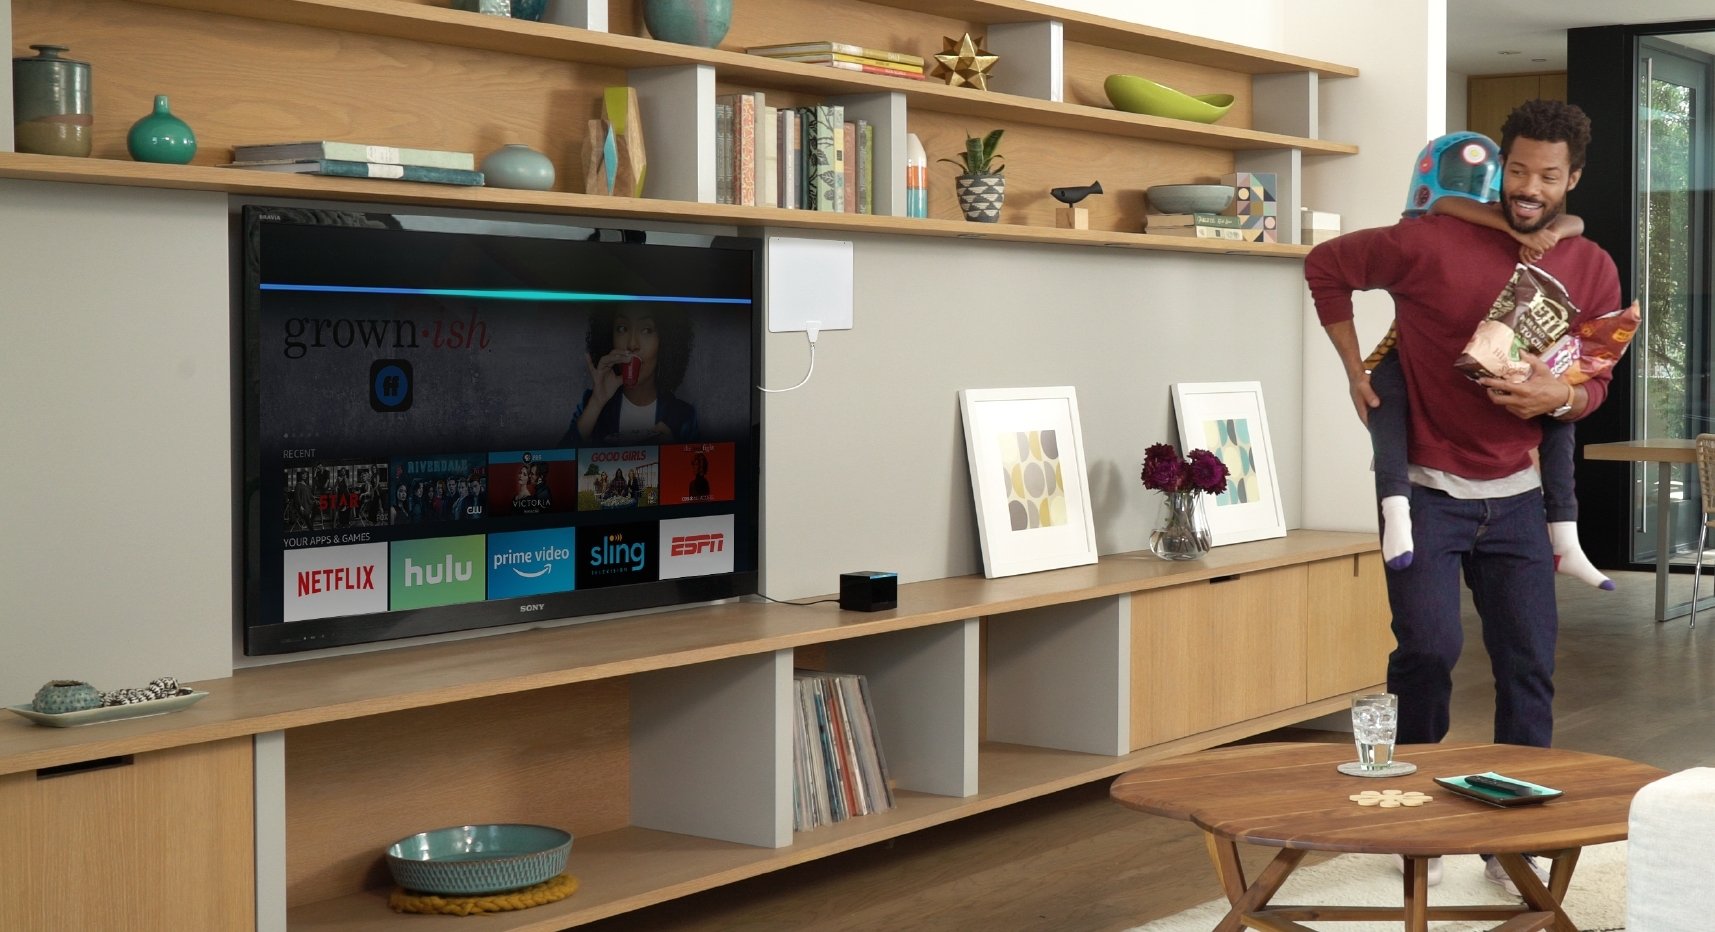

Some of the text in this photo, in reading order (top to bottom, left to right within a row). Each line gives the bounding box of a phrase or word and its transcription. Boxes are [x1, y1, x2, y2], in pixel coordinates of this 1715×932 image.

[283, 449, 316, 459] RECENT
[591, 451, 647, 462] GOOD GIRLS
[407, 459, 468, 474] RIVERDALE
[319, 493, 360, 510] STAR
[512, 499, 551, 509] VICTORIA
[283, 532, 371, 548] YOUR APPS & GAMES
[670, 533, 724, 557] ESPN
[493, 546, 570, 570] prime video
[590, 534, 645, 572] sling
[404, 554, 473, 587] hulu
[298, 565, 375, 598] NETFLIX
[520, 603, 545, 612] SONY
